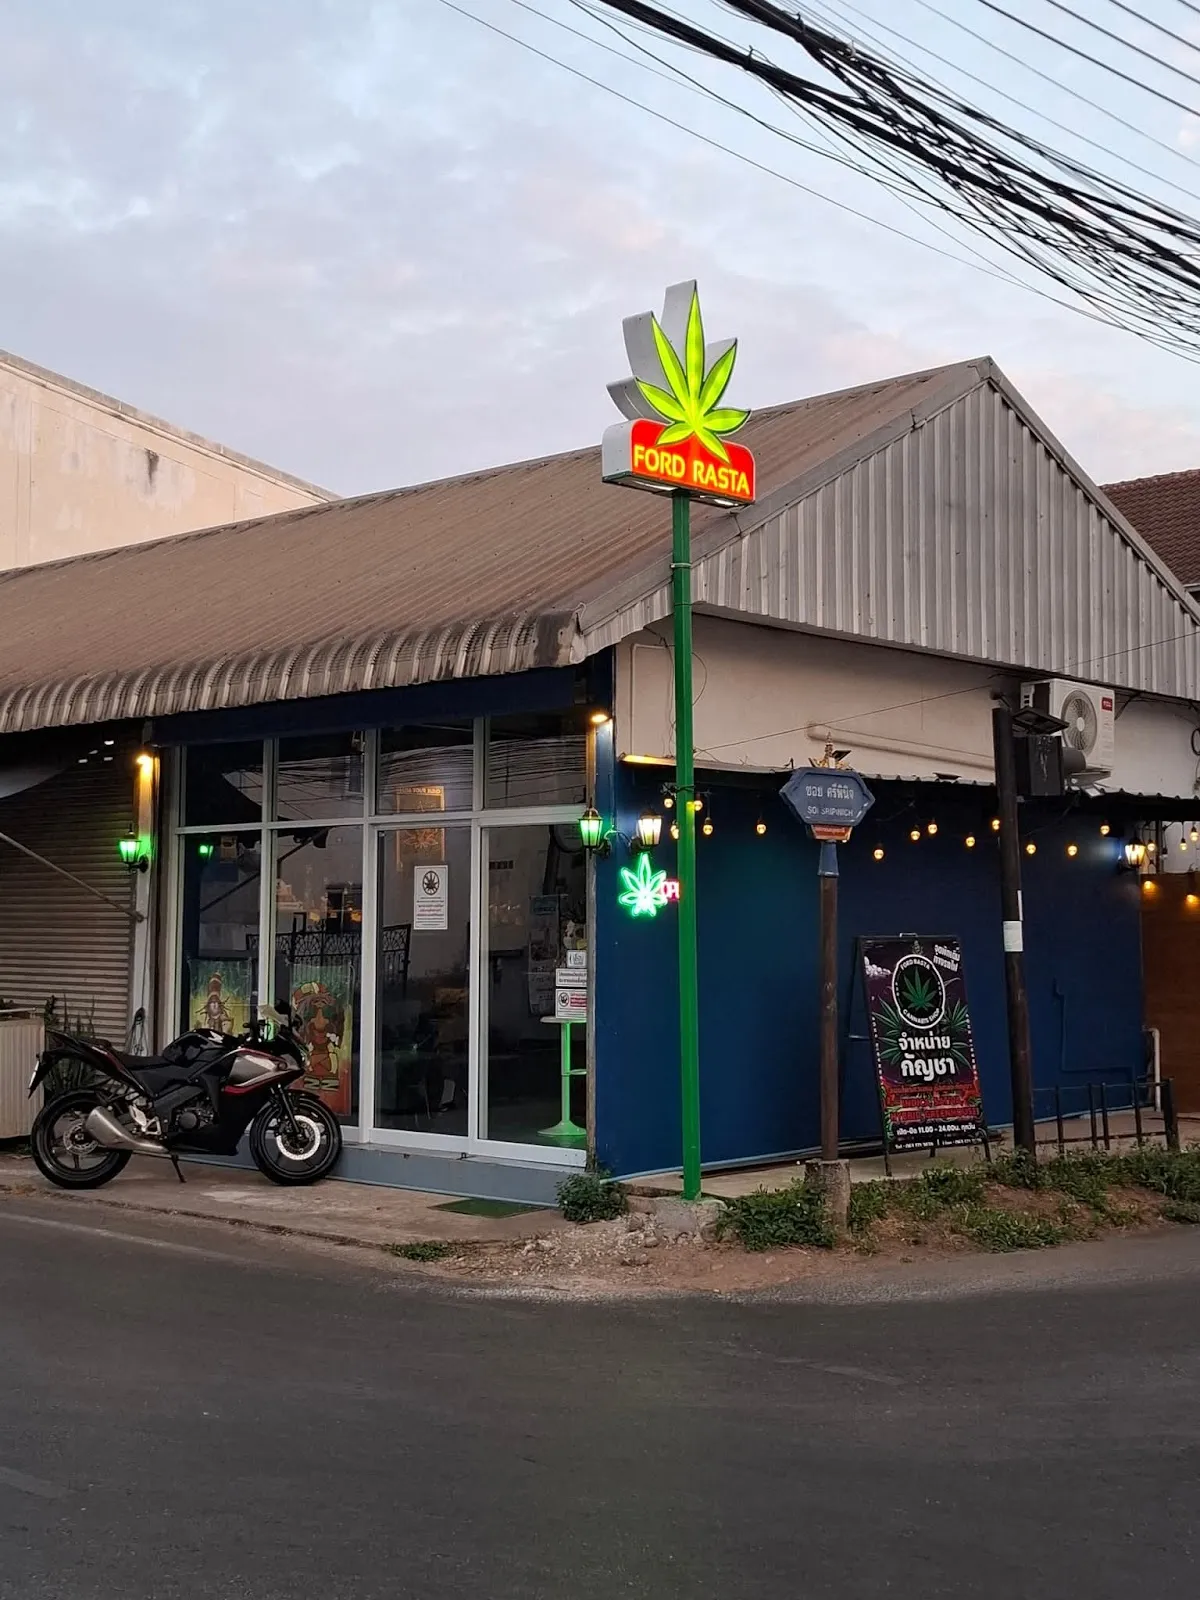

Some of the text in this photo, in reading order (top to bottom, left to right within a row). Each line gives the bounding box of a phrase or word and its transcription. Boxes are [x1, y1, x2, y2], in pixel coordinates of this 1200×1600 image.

[634, 444, 750, 495] FORD RASTA
[805, 785, 823, 797] ซอย
[807, 805, 819, 815] SOI
[900, 958, 930, 970] FORD RASTA
[902, 1008, 930, 1024] CANNABIS
[898, 1030, 951, 1050] จำหน่าย
[901, 1052, 956, 1081] กัญชา
[918, 1125, 933, 1134] 11.00
